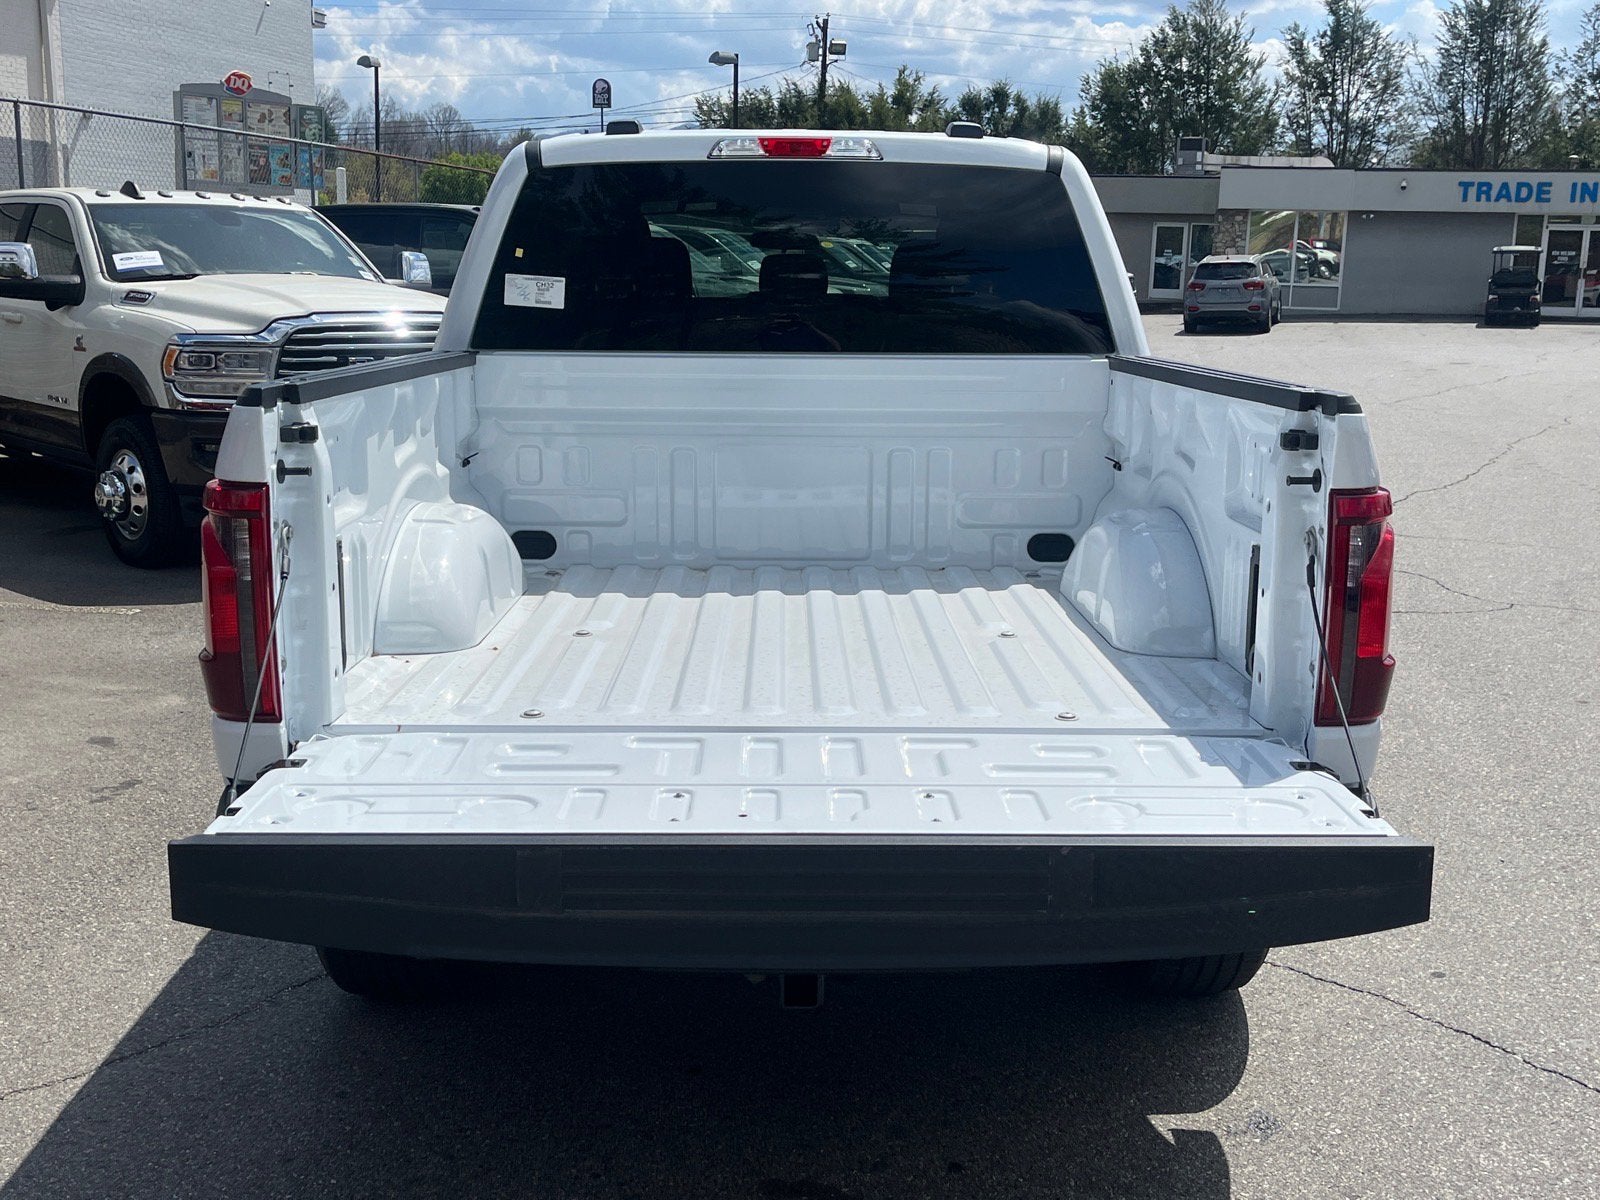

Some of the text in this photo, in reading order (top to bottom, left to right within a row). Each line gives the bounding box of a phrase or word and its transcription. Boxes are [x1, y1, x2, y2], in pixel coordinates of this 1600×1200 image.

[230, 75, 250, 92] DQ
[1458, 181, 1600, 203] TRADE IN
